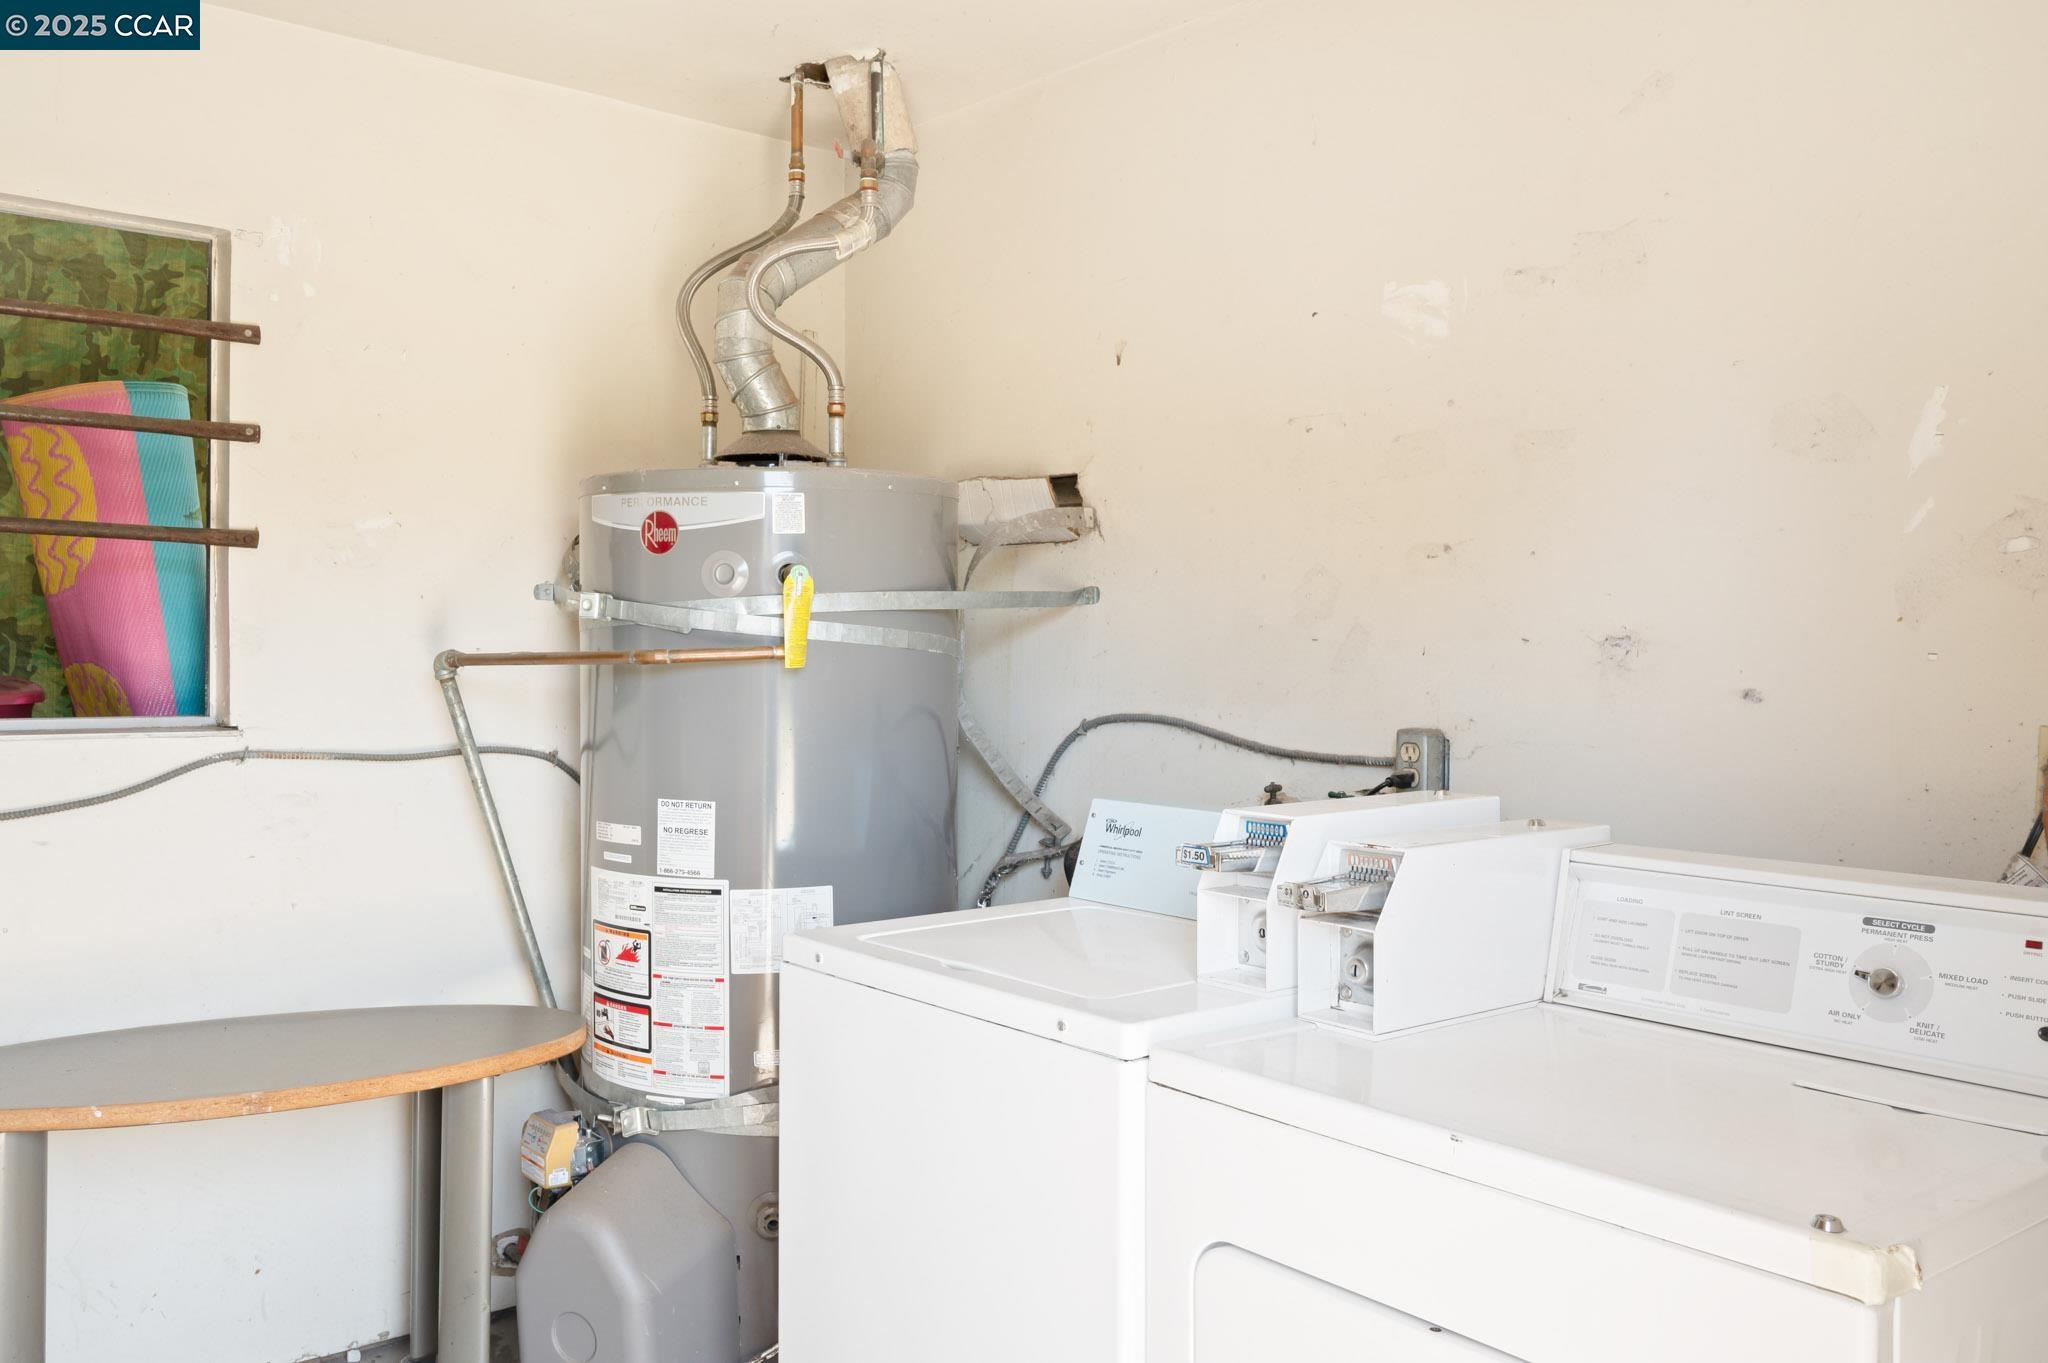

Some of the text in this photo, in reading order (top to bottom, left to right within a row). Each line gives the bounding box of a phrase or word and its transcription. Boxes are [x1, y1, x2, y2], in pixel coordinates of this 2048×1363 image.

[645, 512, 676, 548] Rheem
[1106, 823, 1142, 838] Whirlpool
[1183, 850, 1204, 861] $1.50
[1617, 896, 1643, 904] LOADING
[1720, 908, 1762, 920] LINT SCREEN
[1872, 920, 1925, 932] SELECT CYCLE
[1862, 928, 1934, 943] PERMANENT PRESS
[1814, 952, 1844, 962] COTTON
[1816, 959, 1844, 969] STURDY
[1939, 973, 1988, 985] MIXED LOAD
[2008, 993, 2026, 1001] PUSH
[1828, 1009, 1862, 1021] AIR ONLY
[1917, 1022, 1934, 1030] KNIT
[1910, 1028, 1945, 1039] DELICATE
